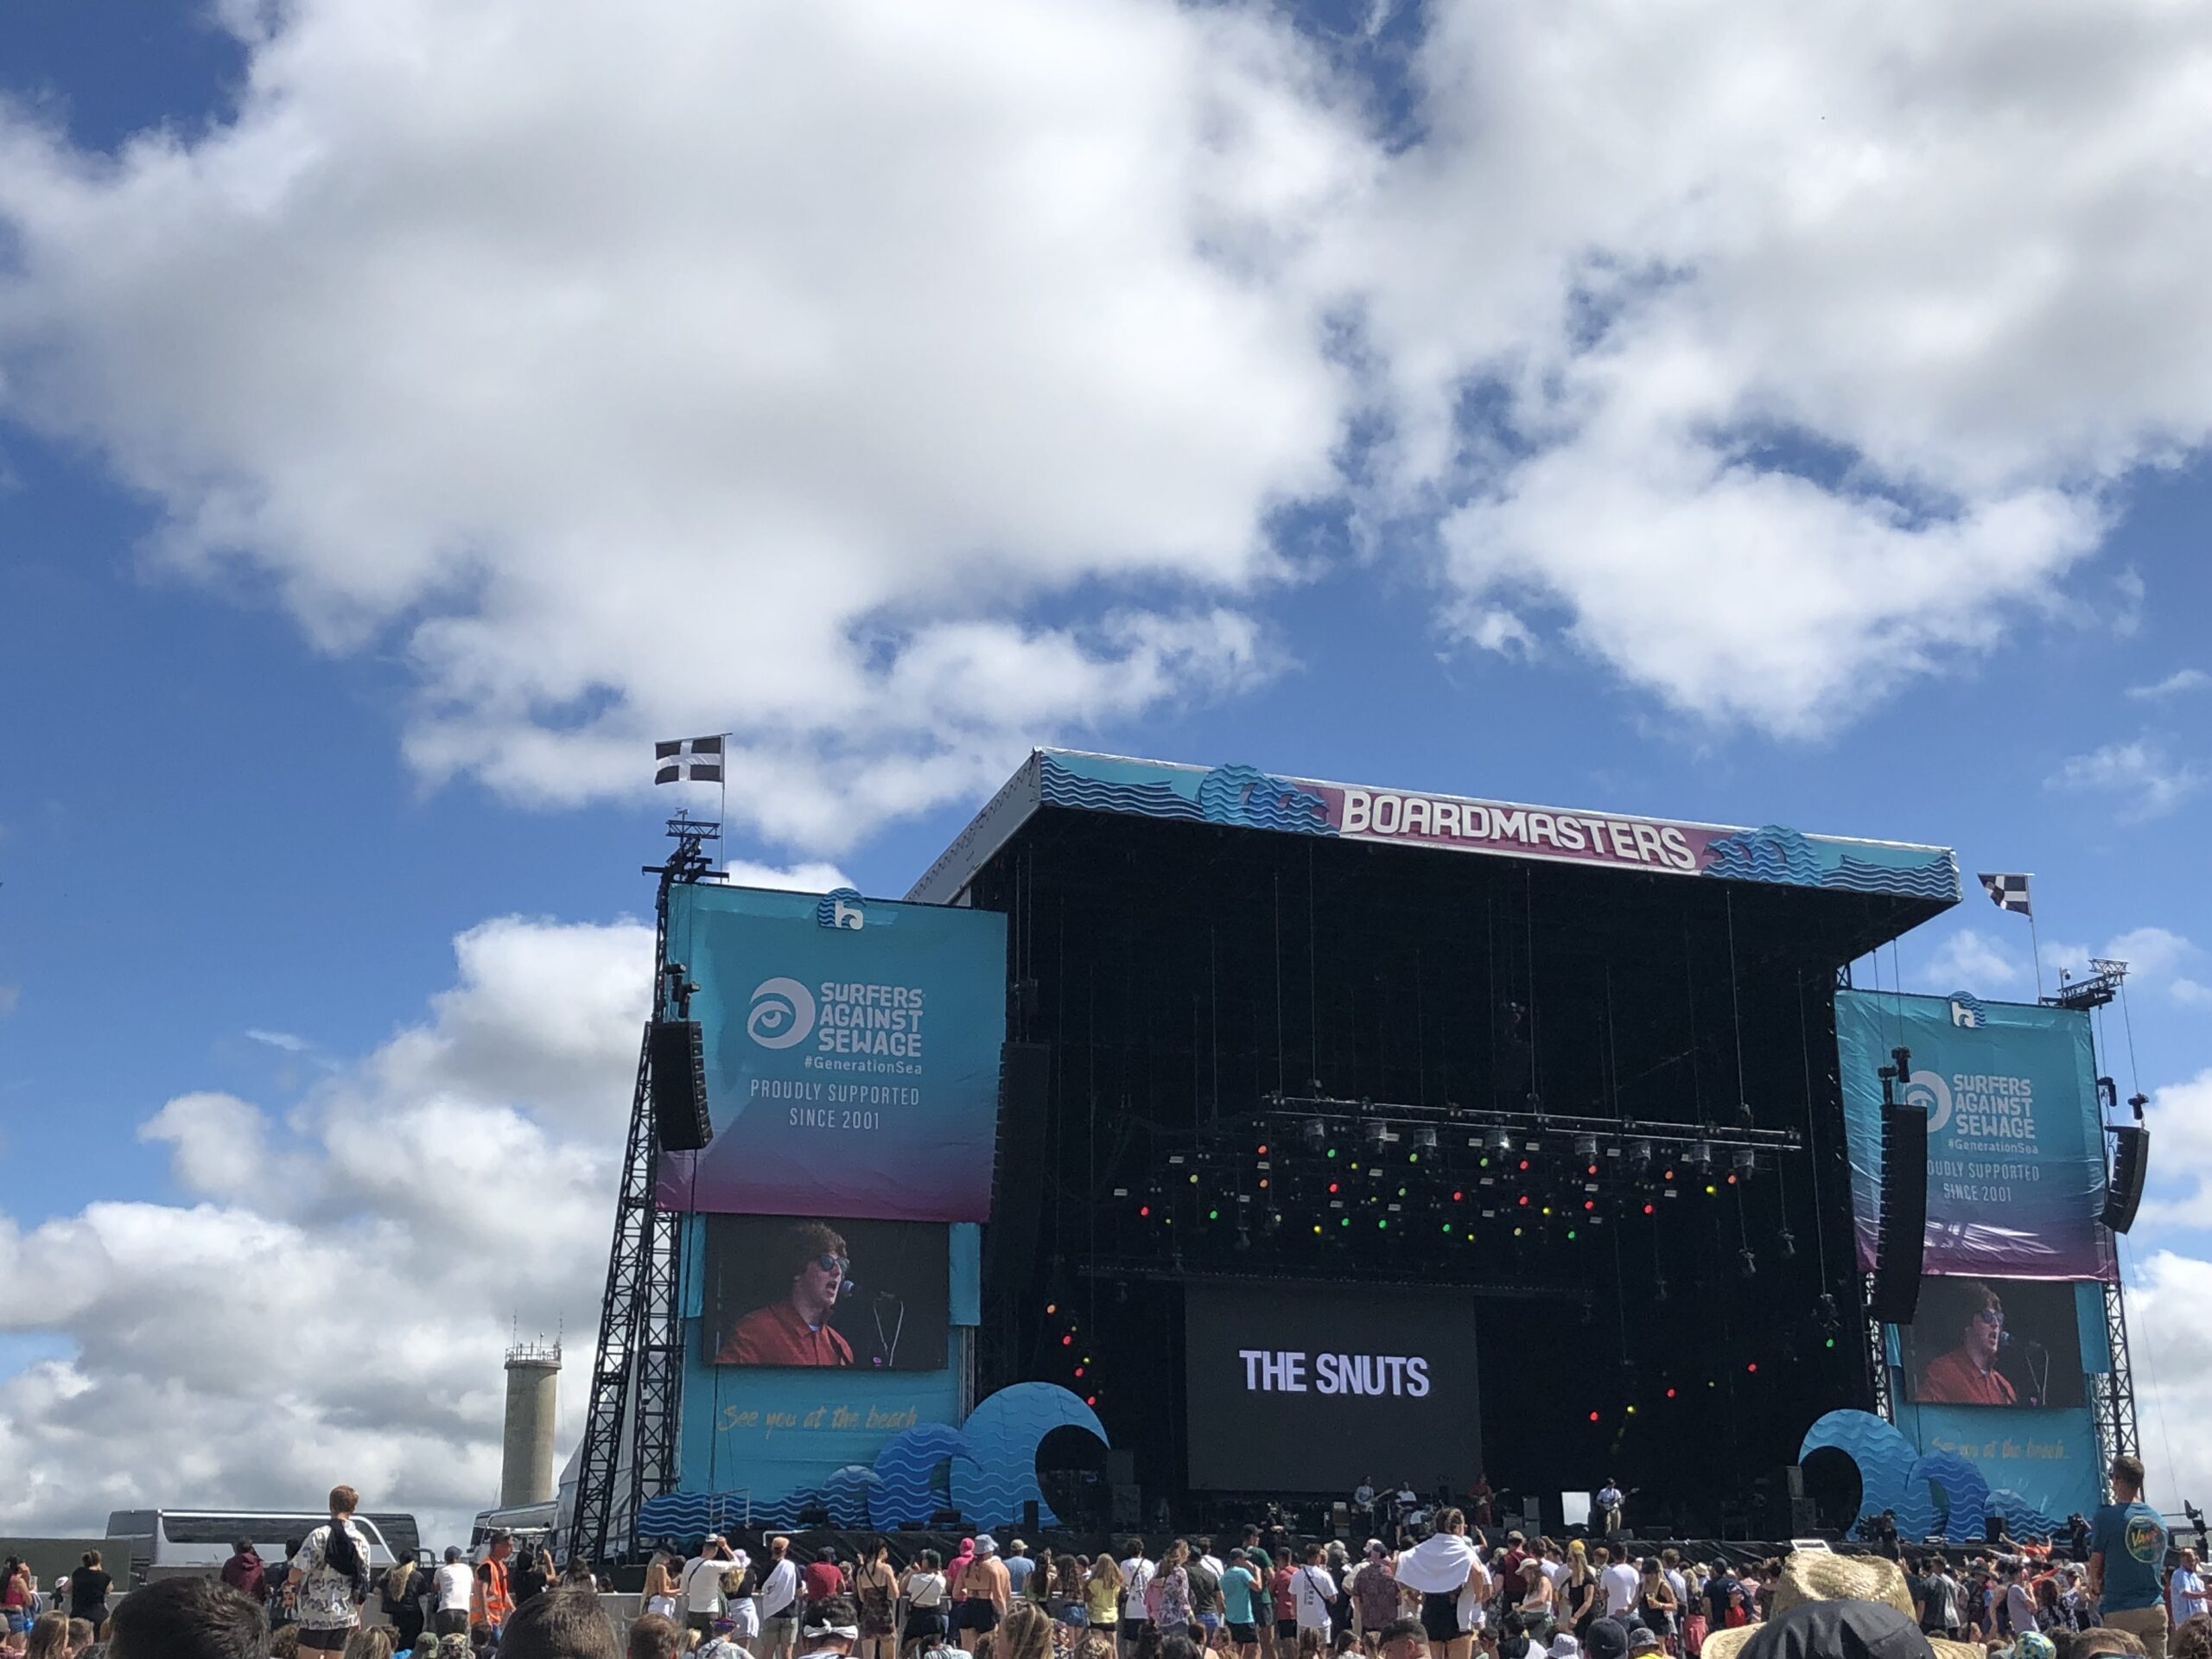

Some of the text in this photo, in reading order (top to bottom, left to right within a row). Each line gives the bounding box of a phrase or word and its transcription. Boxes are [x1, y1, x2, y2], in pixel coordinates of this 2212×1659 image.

[1340, 790, 1697, 870] BOARDMASTERS
[821, 982, 923, 1008] SURFERS
[819, 1003, 923, 1032] AGAINST
[817, 1027, 922, 1058] SEWAGE
[804, 1055, 922, 1075] #GenerationSea
[750, 1079, 919, 1106] PROUDLY SUPPORTED
[1953, 1074, 2031, 1096] SURFERS
[1955, 1093, 2033, 1117] AGAINST
[789, 1107, 880, 1130] SINCE 2001
[1955, 1115, 2036, 1139] SEWAGE
[1948, 1138, 2039, 1154] #GenerationSea
[1927, 1160, 2040, 1182] OUDLY SUPPORTED
[1943, 1182, 2012, 1203] SINCE 2001
[1239, 1350, 1430, 1397] THE SNUTS
[718, 1404, 918, 1440] See you at the beach
